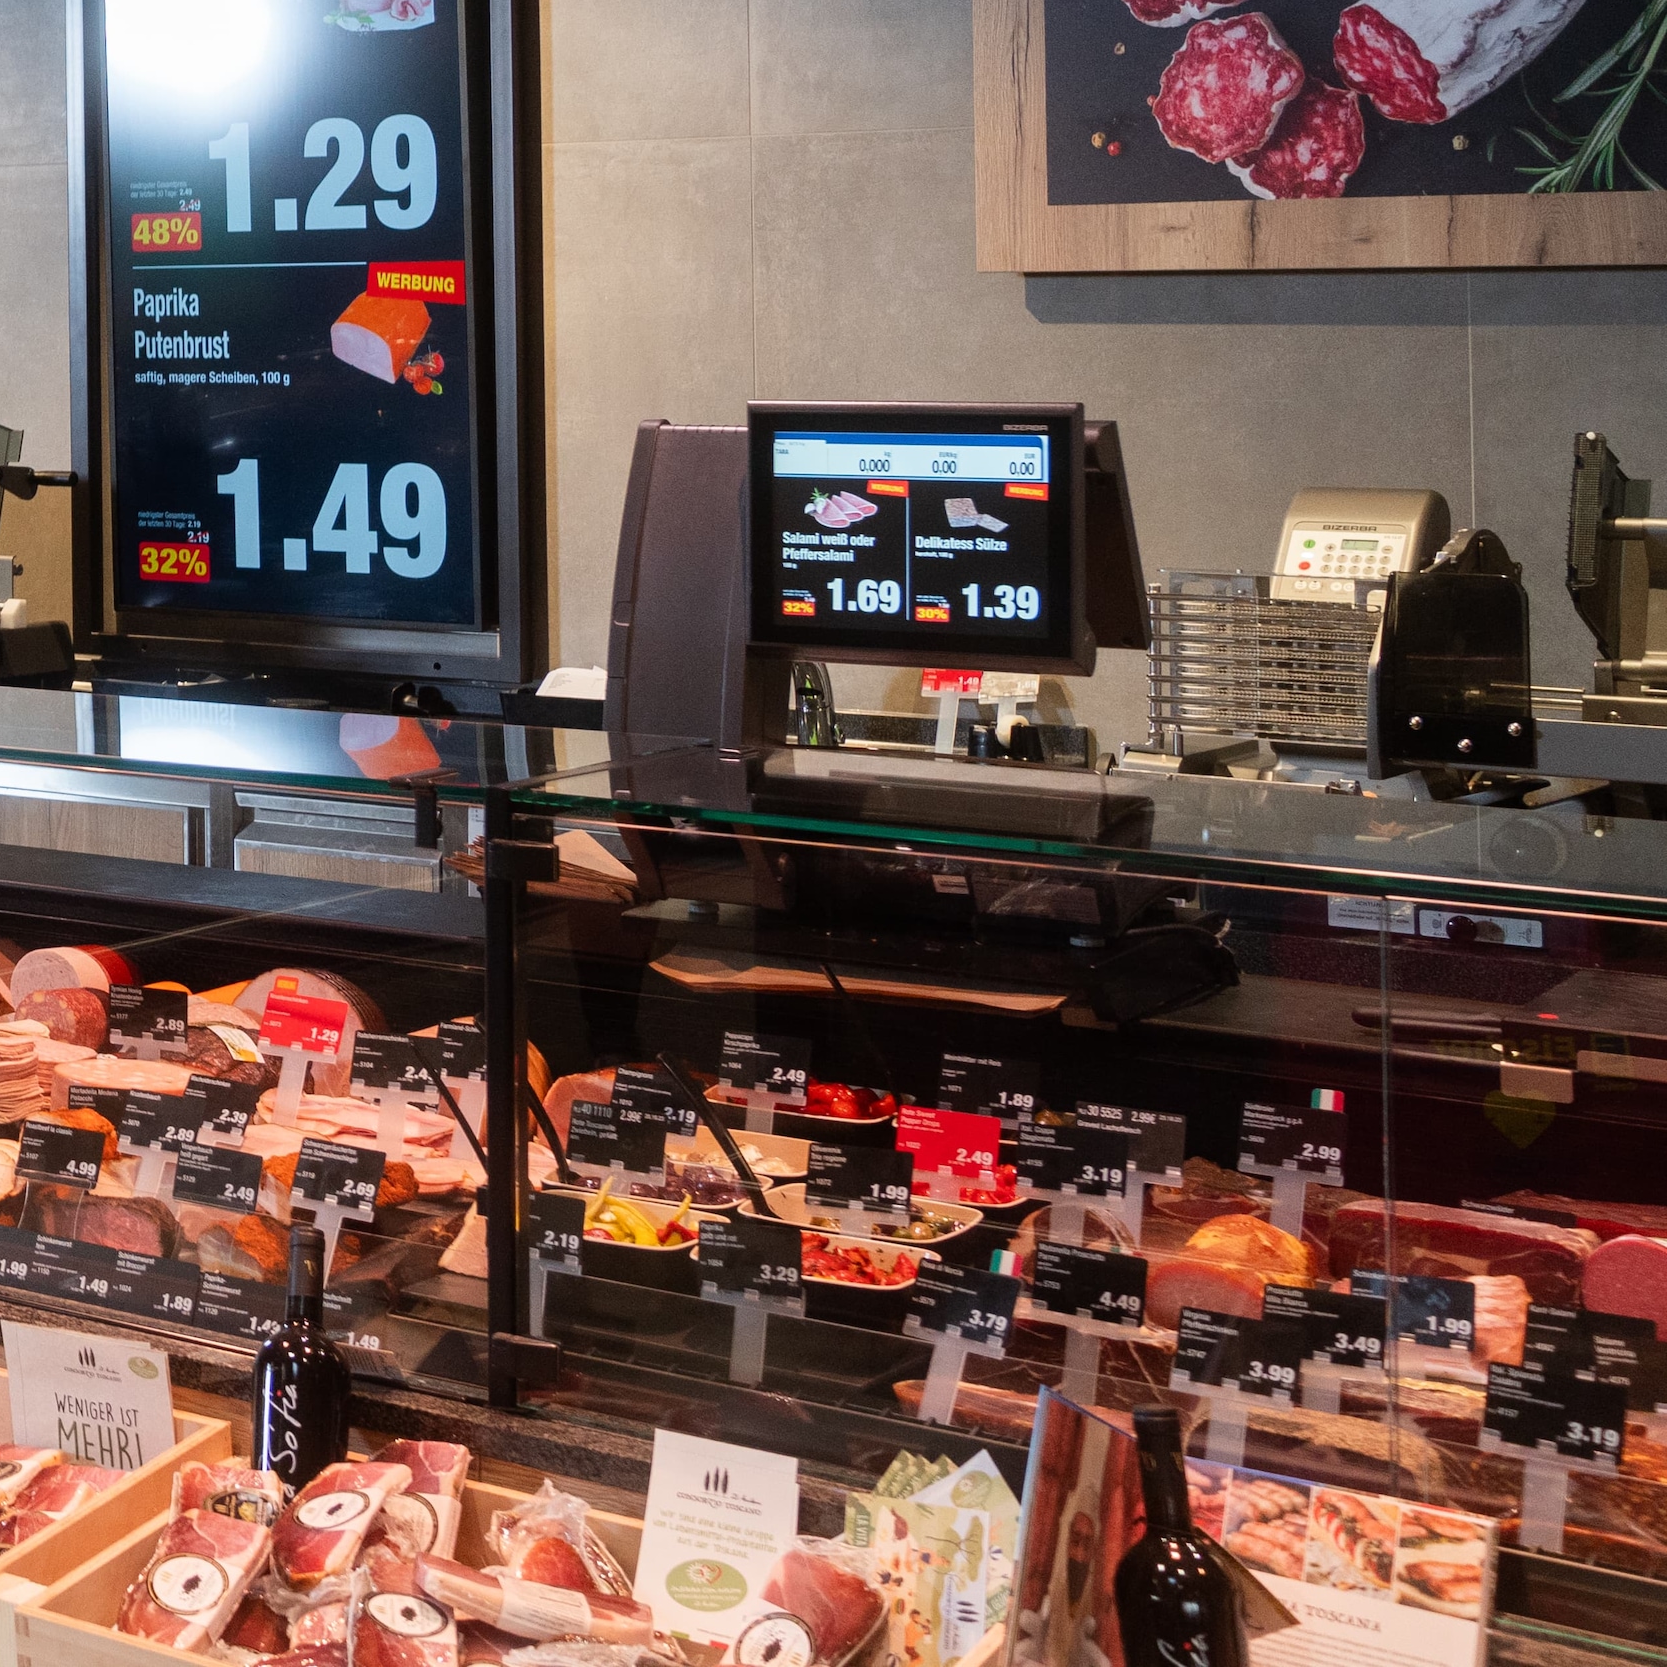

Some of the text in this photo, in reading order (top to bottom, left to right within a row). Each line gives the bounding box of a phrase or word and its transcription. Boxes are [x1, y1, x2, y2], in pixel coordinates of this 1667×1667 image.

[208, 113, 438, 233] 1.29
[133, 218, 198, 246] 48%
[377, 272, 456, 294] WERBUNG
[133, 288, 200, 323] Paprika
[135, 329, 230, 361] Putenbrust
[135, 370, 291, 387] saftig, magere Scheiben, 100 g
[217, 457, 448, 580] 1.49
[1322, 524, 1378, 532] BIZERBA
[186, 530, 210, 544] 2.19
[782, 531, 876, 547] Salami weiß oder
[915, 535, 1008, 552] Delikatess Sülze
[140, 546, 207, 577] 32%
[782, 547, 855, 563] Pfeffersalami
[827, 577, 901, 615] 1.69
[961, 582, 1041, 620] 1.39
[783, 601, 814, 615] 32%
[916, 607, 948, 622] 30%
[156, 1016, 185, 1032] 2.89
[310, 1026, 339, 1043] 1.29
[724, 1038, 760, 1051] Kirschpaprika
[618, 1067, 654, 1080] Champignons
[772, 1066, 806, 1083] 2.49
[70, 1086, 118, 1098] Mortadella Modena
[998, 1090, 1035, 1110] 1.89
[219, 1108, 248, 1125] 2.39
[1087, 1104, 1157, 1125] 30 5525 2.99€
[26, 1120, 47, 1132] Roastbeef
[165, 1125, 195, 1143] 2.89
[956, 1147, 993, 1167] 2.49
[1302, 1142, 1341, 1162] 2.99
[66, 1159, 97, 1177] 4.99
[1082, 1165, 1123, 1185] 3.19
[224, 1183, 256, 1201] 2.49
[343, 1179, 376, 1198] 2.69
[870, 1182, 909, 1202] 1.99
[1461, 1199, 1515, 1215] Schwarzwälder
[36, 1234, 72, 1249] Schinkenwurst
[544, 1230, 580, 1250] 2.19
[0, 1258, 28, 1278] 1.99
[117, 1250, 156, 1266] Schinkenwurst
[760, 1264, 799, 1283] 3.29
[78, 1275, 108, 1295] 1.49
[202, 1281, 242, 1296] Schinkenwurst
[162, 1292, 193, 1312] 1.89
[1099, 1291, 1141, 1312] 4.49
[968, 1309, 1008, 1331] 3.79
[1427, 1315, 1472, 1336] 1.99
[348, 1330, 380, 1350] 1.49
[1334, 1332, 1381, 1356] 3.49
[1249, 1360, 1297, 1385] 3.99
[54, 1392, 139, 1427] WENIGER IST
[1567, 1421, 1619, 1448] 3.19
